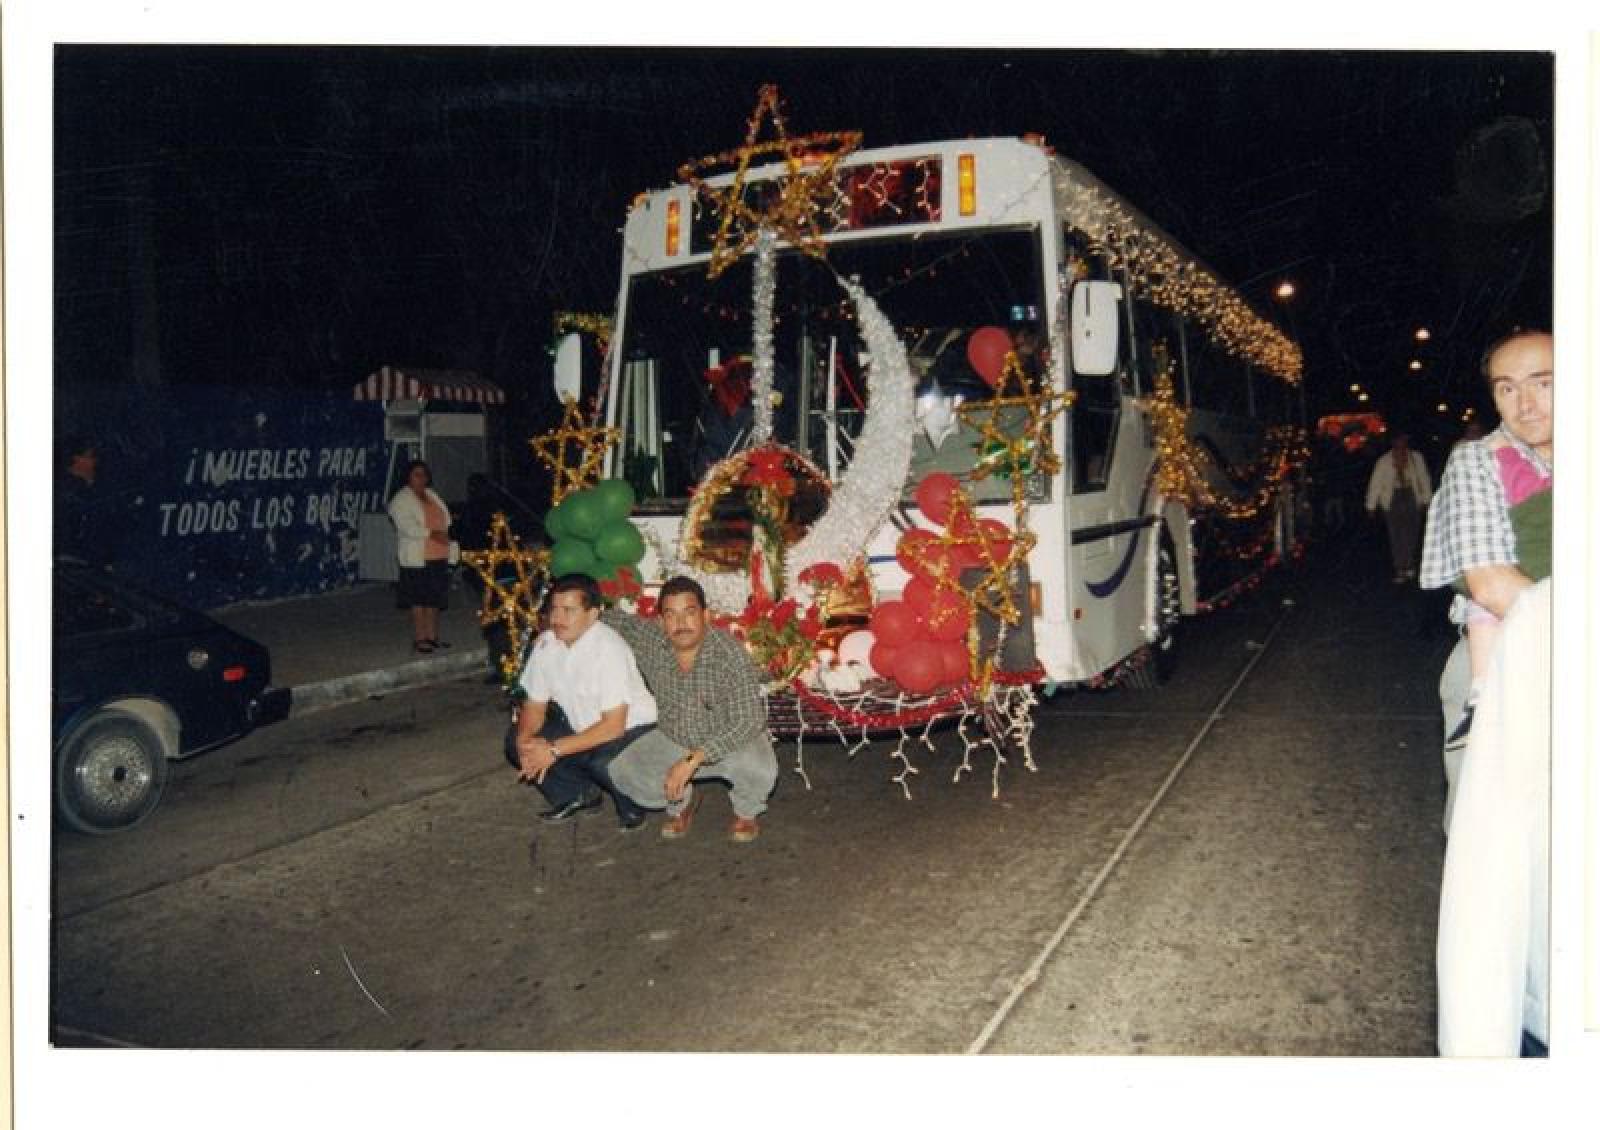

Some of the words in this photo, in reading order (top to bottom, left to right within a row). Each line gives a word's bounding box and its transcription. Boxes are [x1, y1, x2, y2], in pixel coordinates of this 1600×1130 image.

[318, 447, 367, 478] PARA
[160, 501, 241, 536] TODOS
[252, 495, 295, 529] LOS
